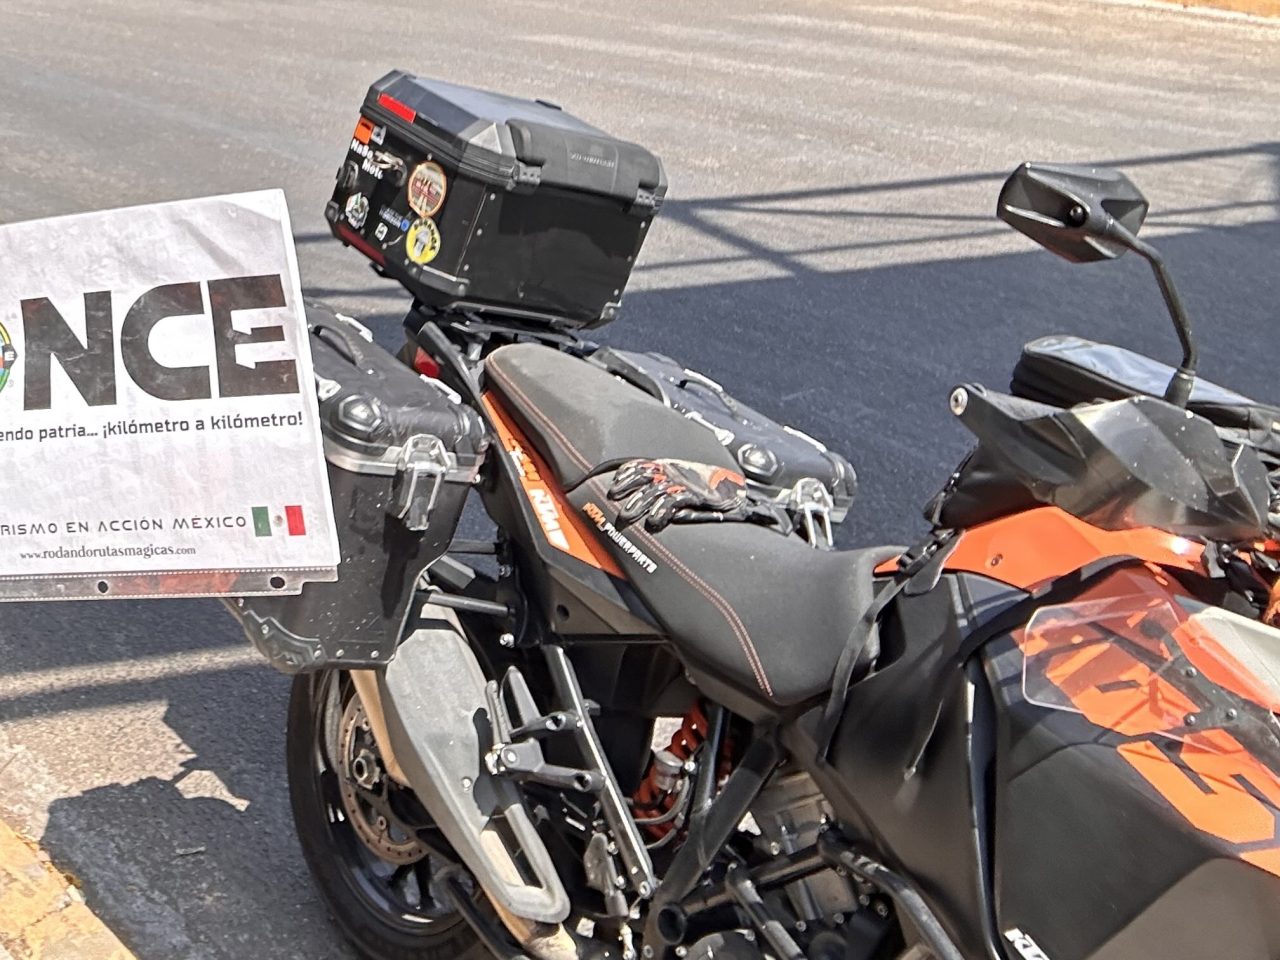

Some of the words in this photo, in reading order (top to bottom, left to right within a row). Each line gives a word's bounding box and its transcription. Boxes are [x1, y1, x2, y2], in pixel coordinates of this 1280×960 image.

[39, 424, 99, 442] patria...
[103, 419, 190, 439] ¡kilómetro
[195, 419, 205, 431] a
[211, 411, 304, 430] kilómetro!
[66, 521, 89, 534] EN
[98, 516, 164, 532] ACCIÓN
[172, 514, 247, 530] MÉXICO
[20, 543, 197, 559] www.rodandorutasmagicas.com
